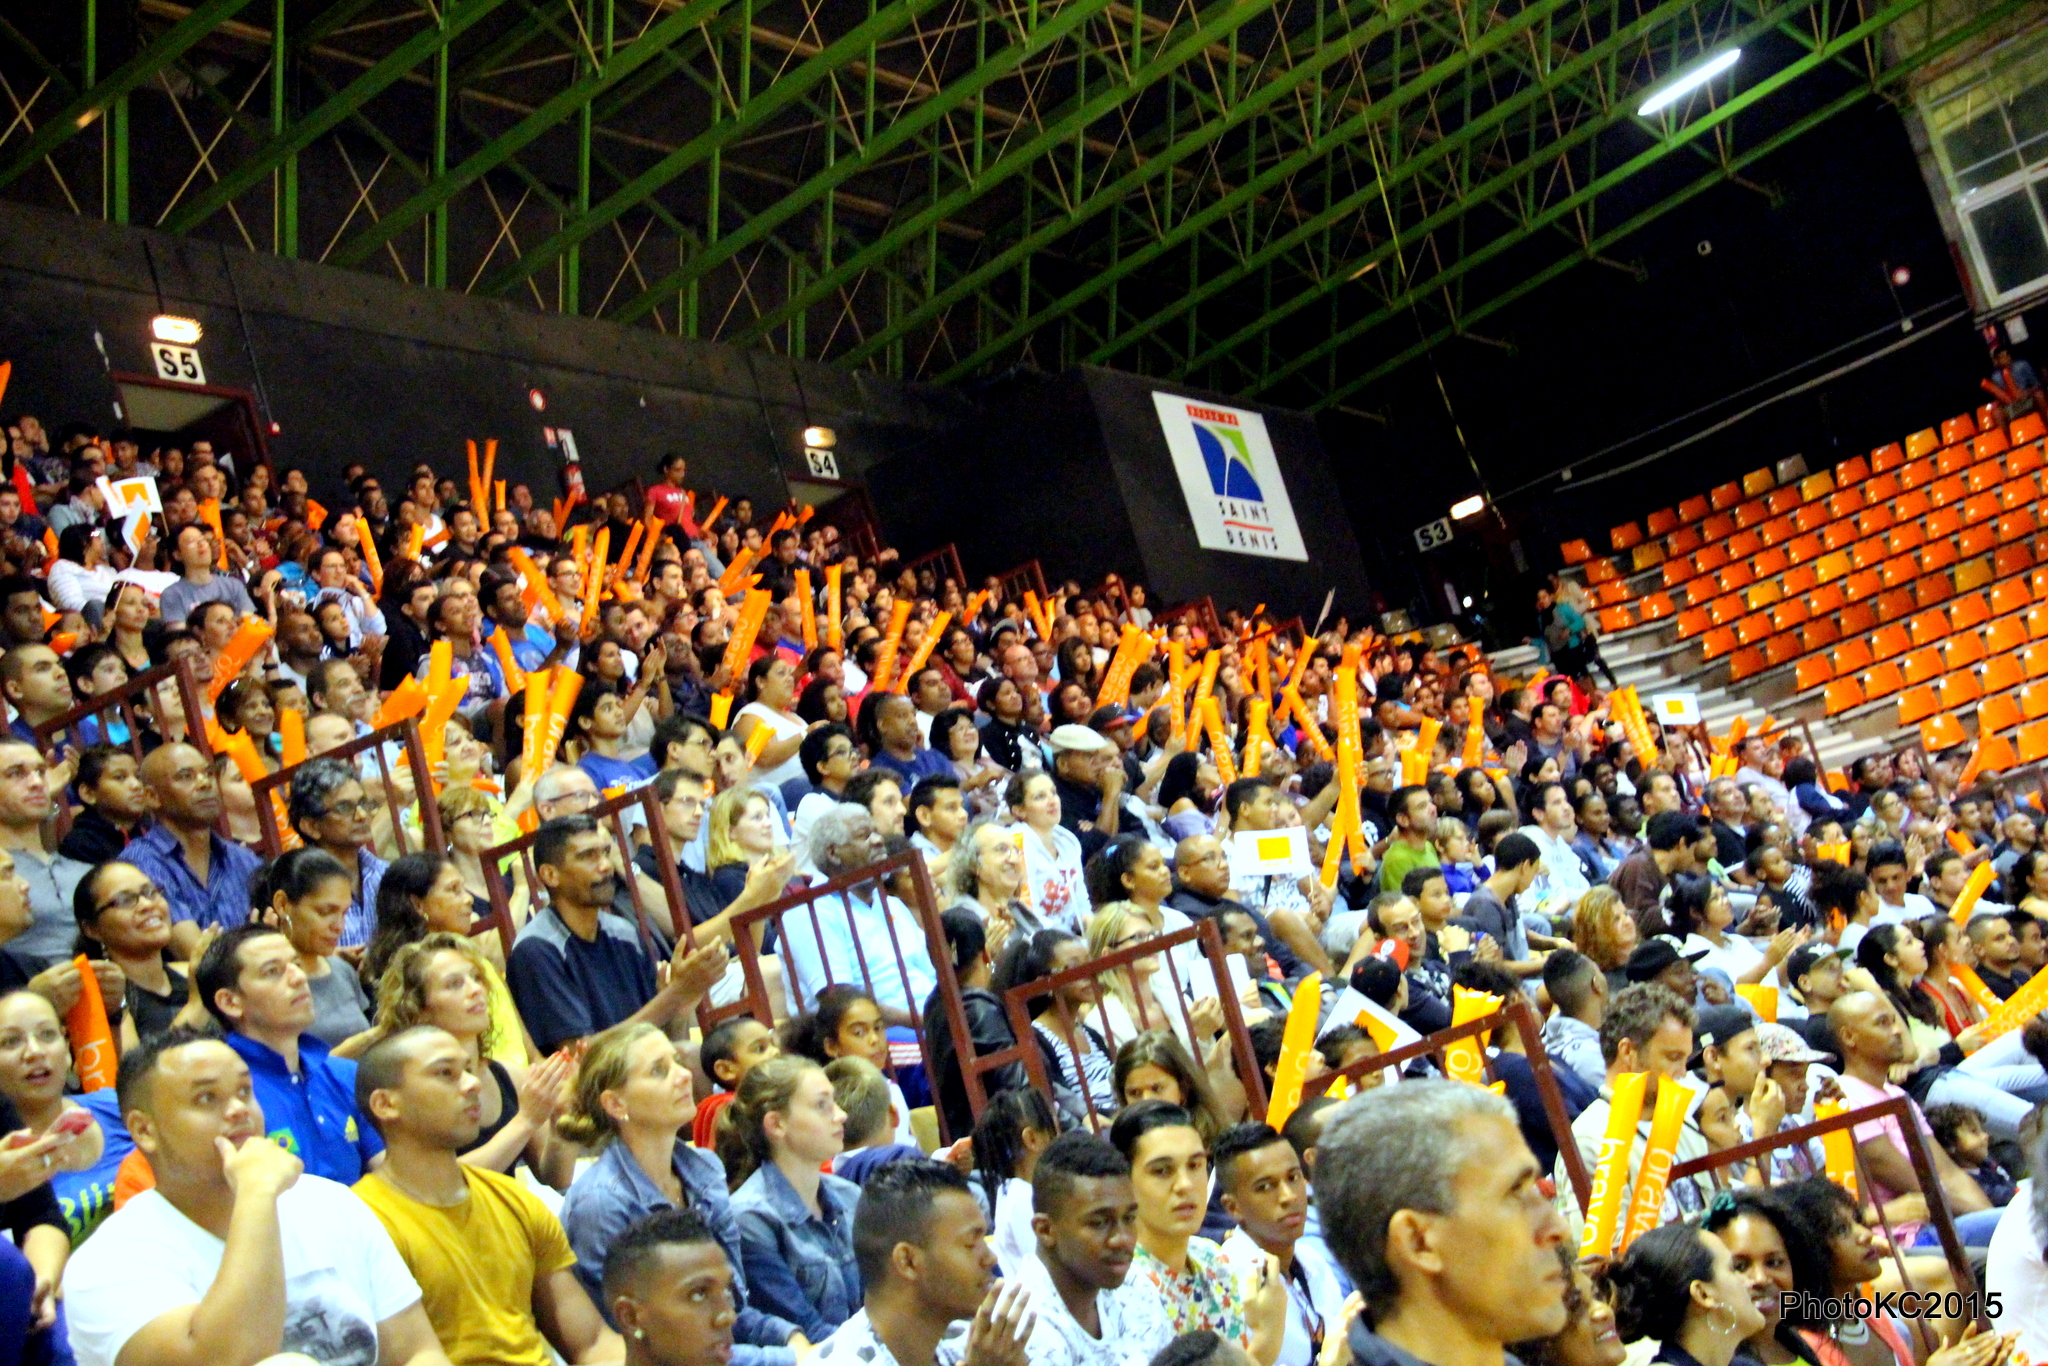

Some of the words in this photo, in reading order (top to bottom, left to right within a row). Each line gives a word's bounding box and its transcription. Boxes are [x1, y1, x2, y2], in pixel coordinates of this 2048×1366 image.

[159, 349, 198, 379] S5
[810, 452, 834, 475] S4
[1218, 500, 1270, 523] SAINT
[1226, 528, 1279, 551] DENIS
[1419, 522, 1447, 547] S3
[1580, 1138, 1626, 1247] bravo
